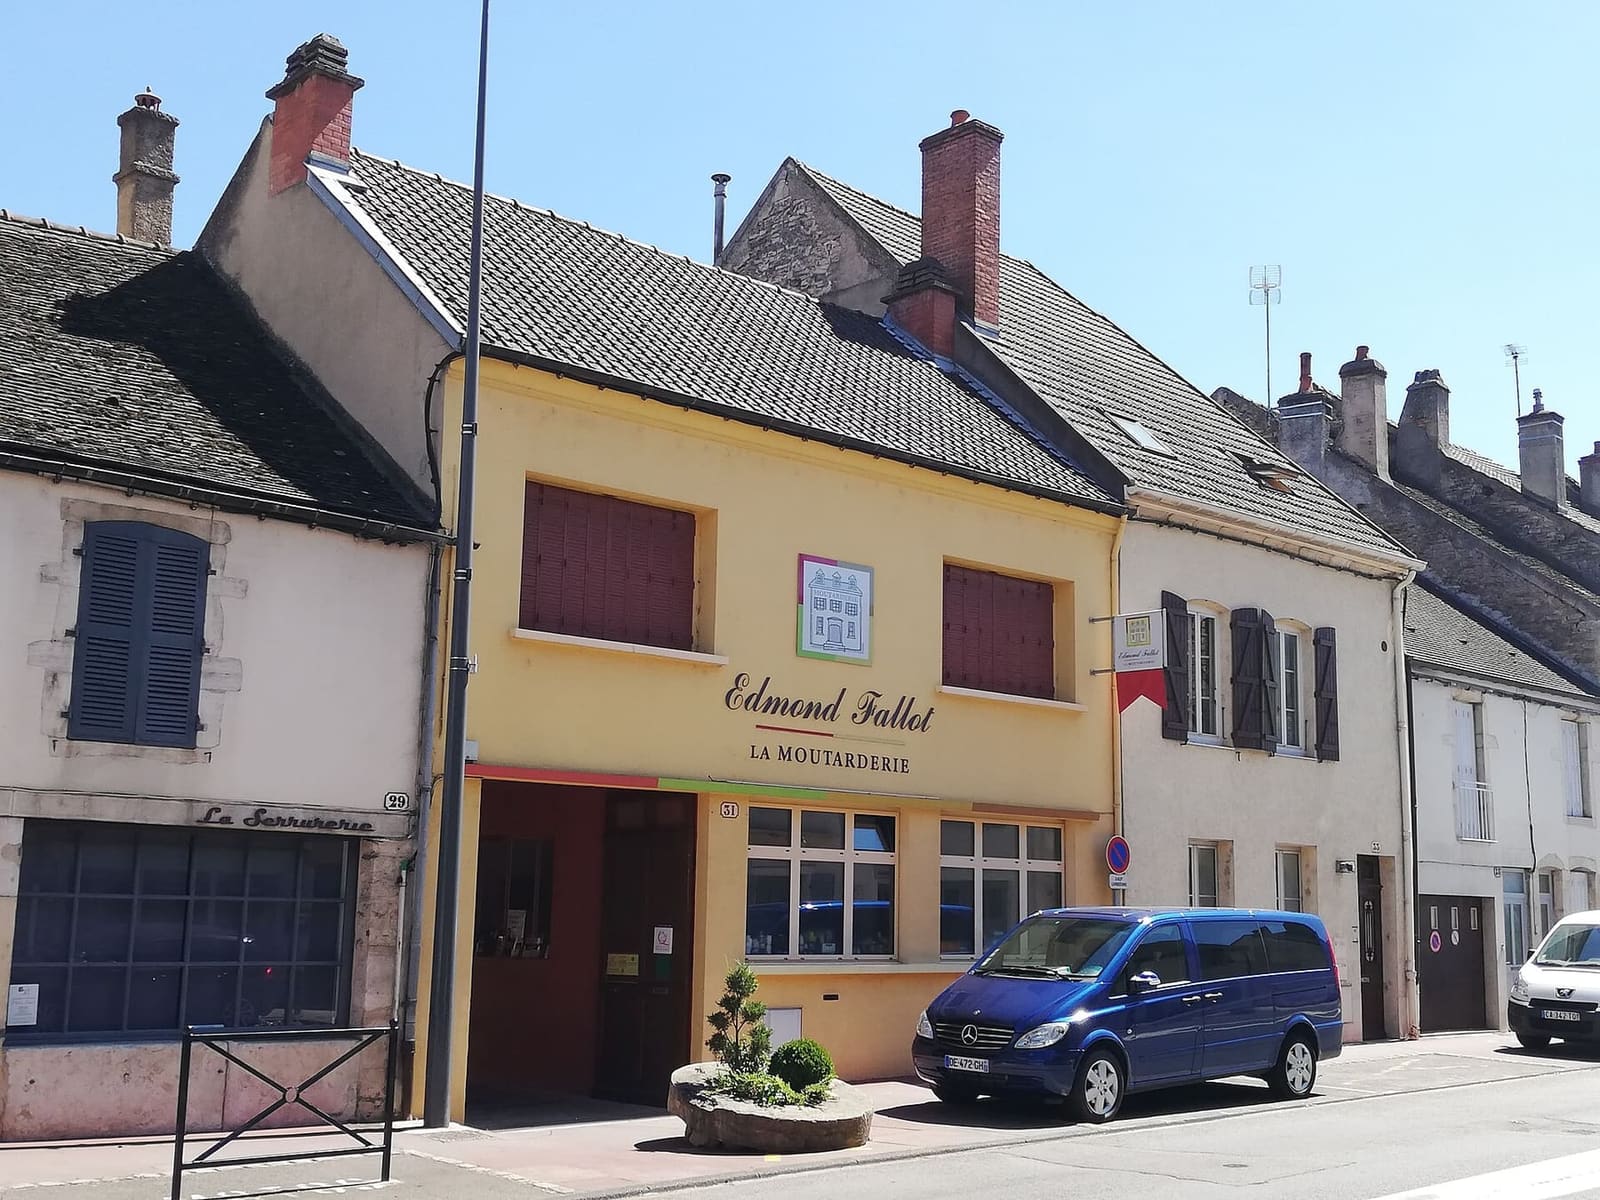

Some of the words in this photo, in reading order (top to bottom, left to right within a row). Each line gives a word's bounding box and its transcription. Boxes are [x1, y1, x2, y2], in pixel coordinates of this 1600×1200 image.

[725, 672, 847, 722] Edmond
[851, 690, 935, 733] Fallot
[750, 745, 770, 760] LA
[777, 745, 910, 774] MOUTARDERIE
[388, 795, 405, 809] 29
[723, 804, 736, 816] 31
[196, 807, 234, 824] La
[243, 808, 376, 832] Serrurerie
